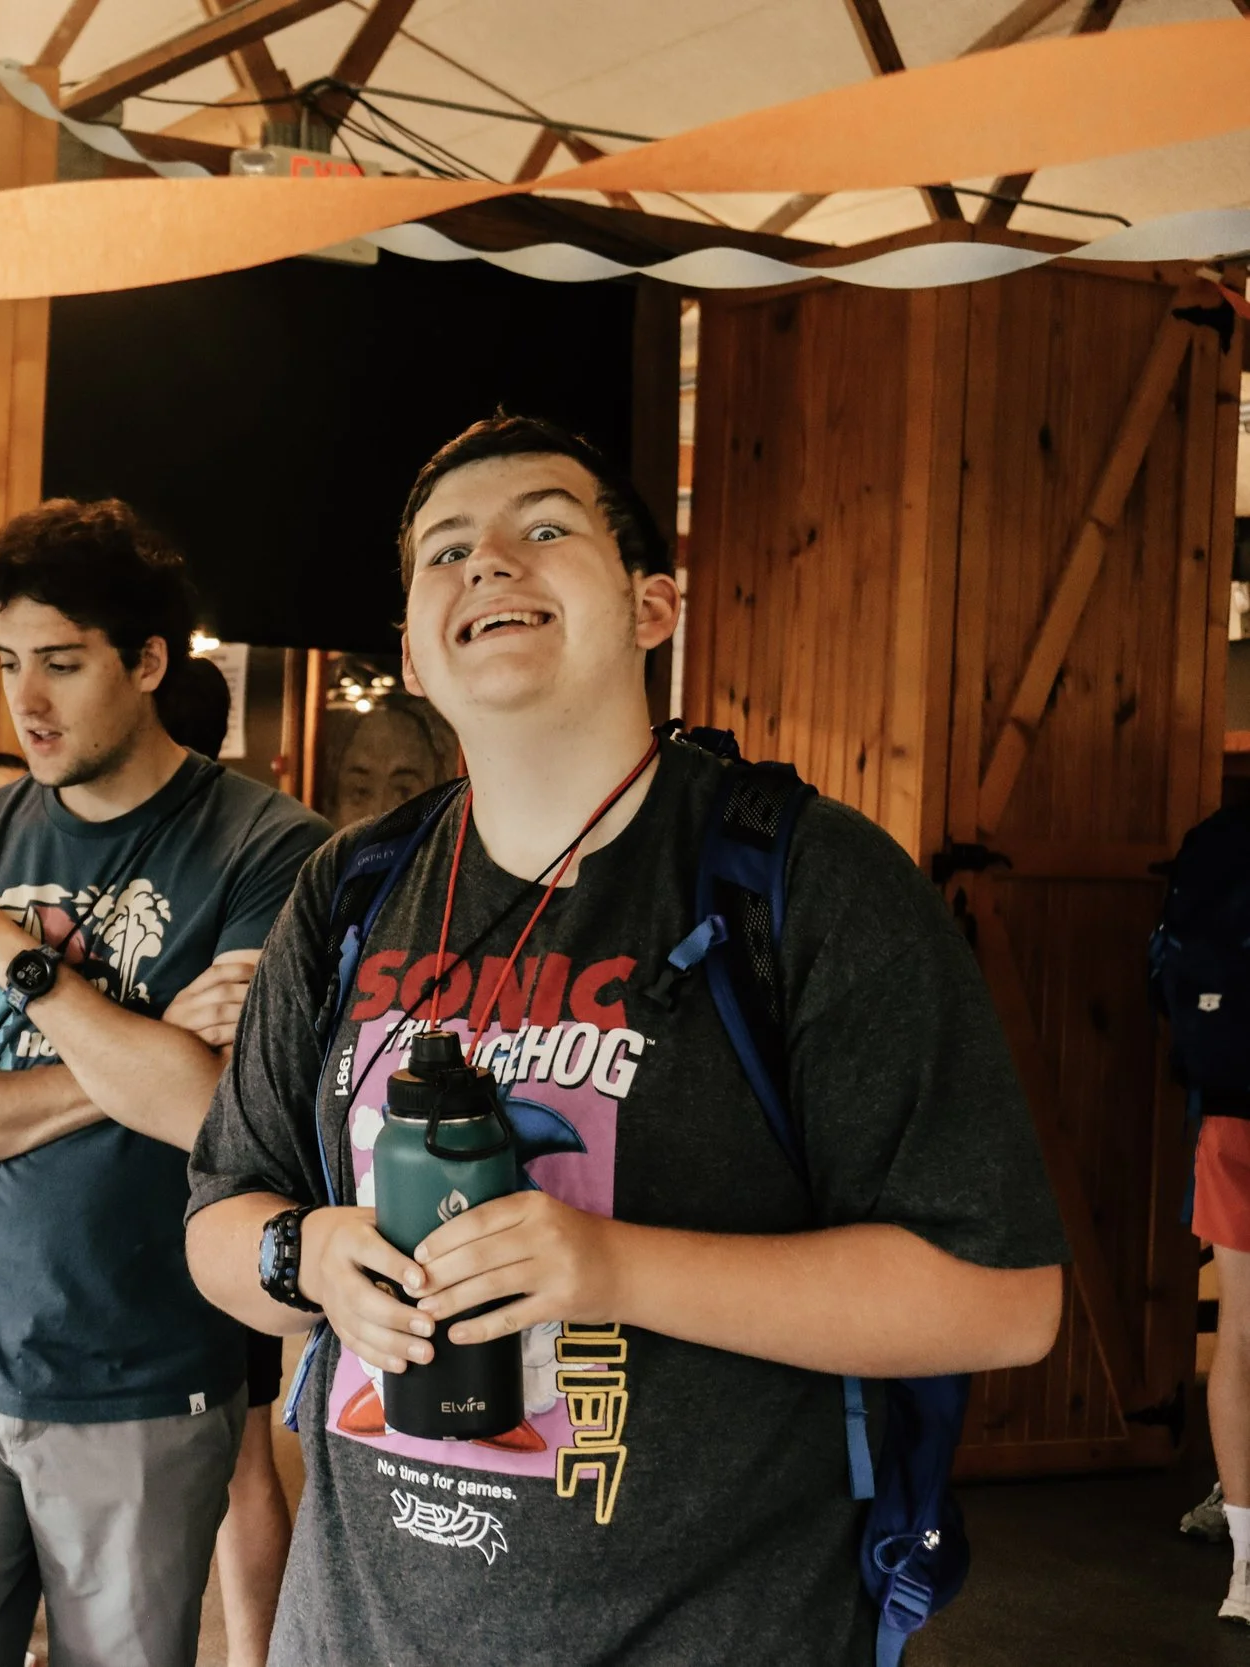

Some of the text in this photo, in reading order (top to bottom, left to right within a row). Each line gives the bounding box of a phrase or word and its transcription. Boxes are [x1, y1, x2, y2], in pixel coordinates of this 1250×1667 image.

[350, 950, 637, 1034] SONIC
[335, 1045, 352, 1095] 1991
[441, 1397, 486, 1413] Elvira
[377, 1458, 517, 1500] No time for games.
